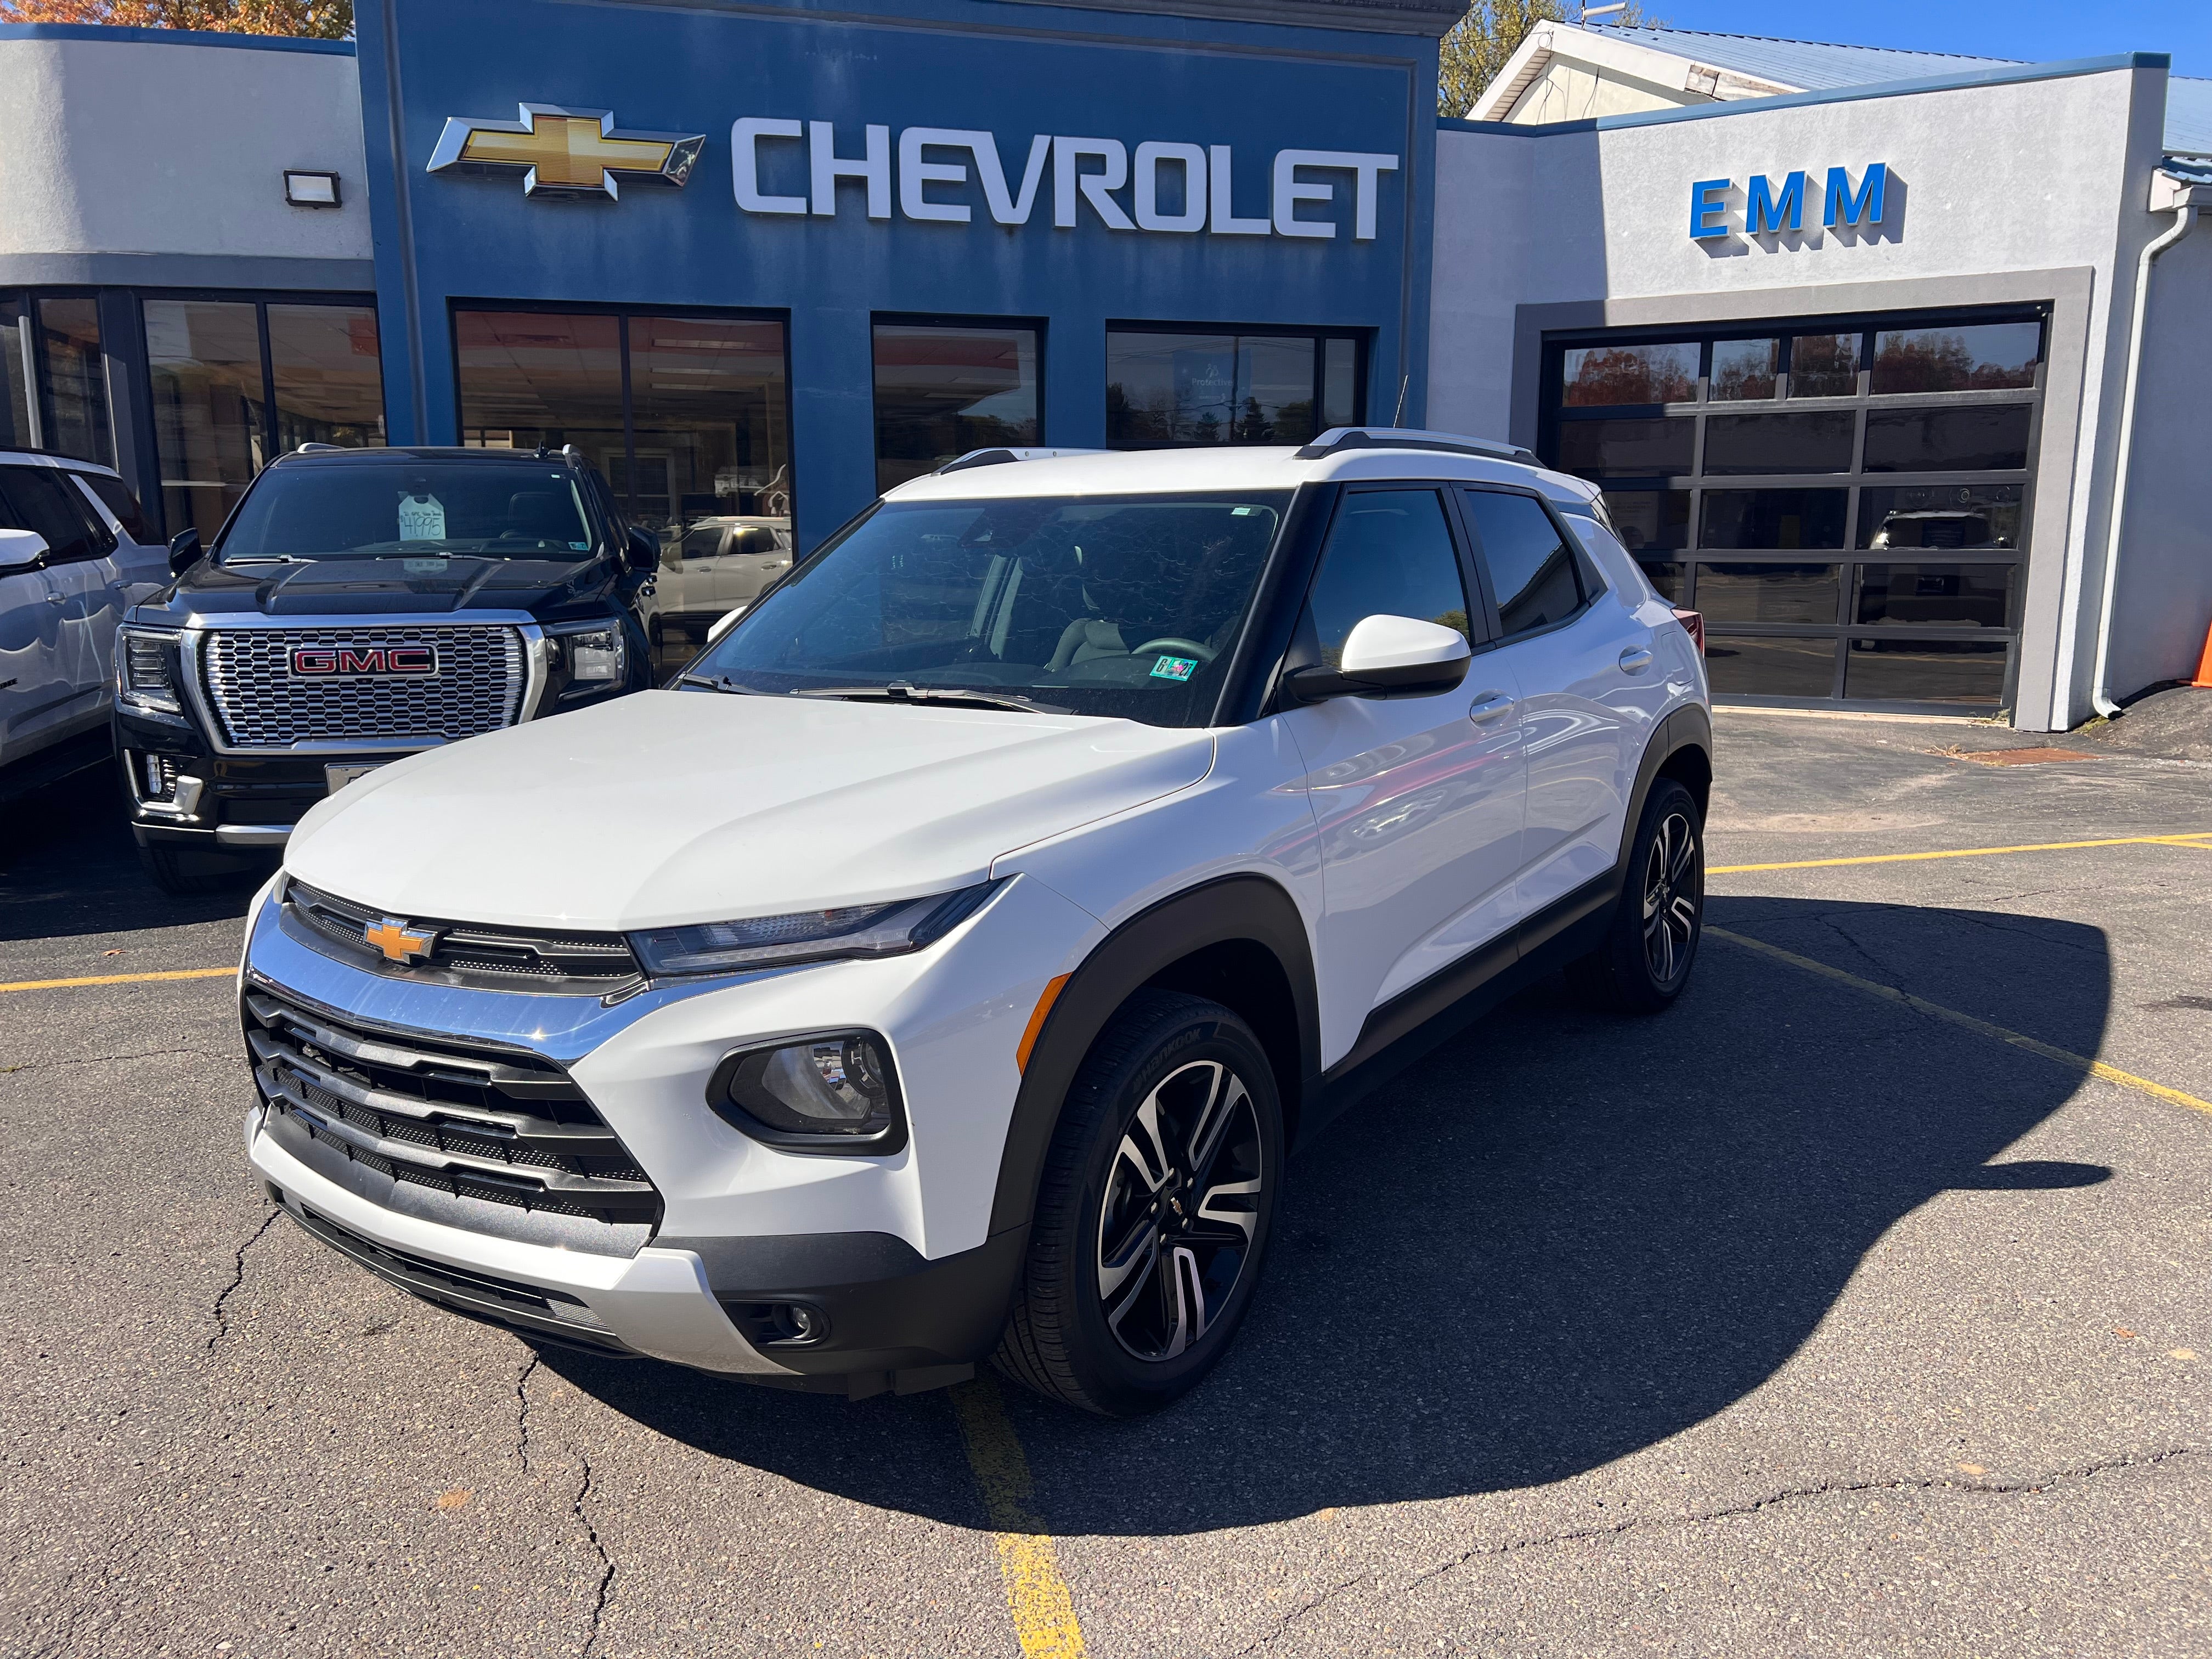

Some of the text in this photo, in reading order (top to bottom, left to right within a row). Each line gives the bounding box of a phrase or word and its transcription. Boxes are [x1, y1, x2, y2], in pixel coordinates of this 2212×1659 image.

[731, 117, 1399, 240] CHEVROLET
[1192, 378, 1233, 386] Protective
[295, 649, 431, 673] GMC
